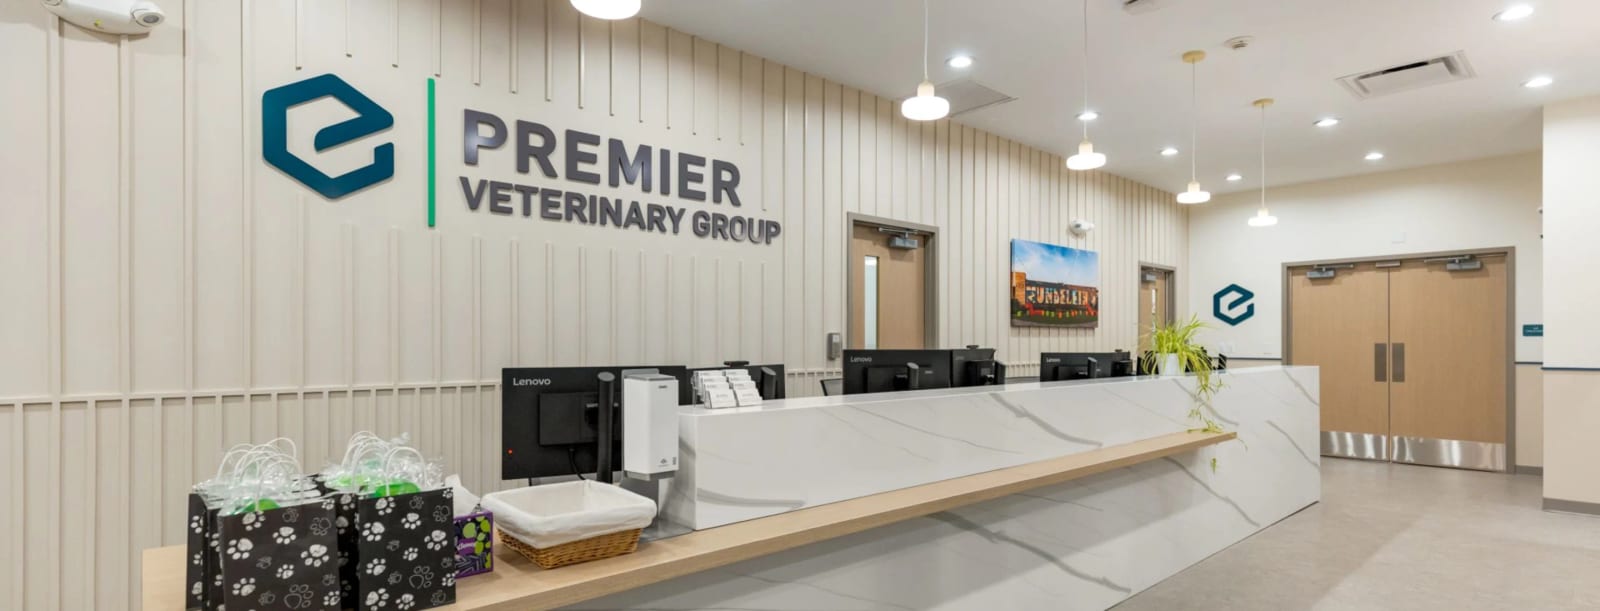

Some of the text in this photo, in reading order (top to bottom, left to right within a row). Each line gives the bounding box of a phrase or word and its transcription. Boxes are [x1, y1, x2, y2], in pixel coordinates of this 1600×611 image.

[463, 108, 741, 206] PREMIER
[459, 176, 781, 244] VETERINARY GROUP
[513, 377, 551, 386] Lenovo
